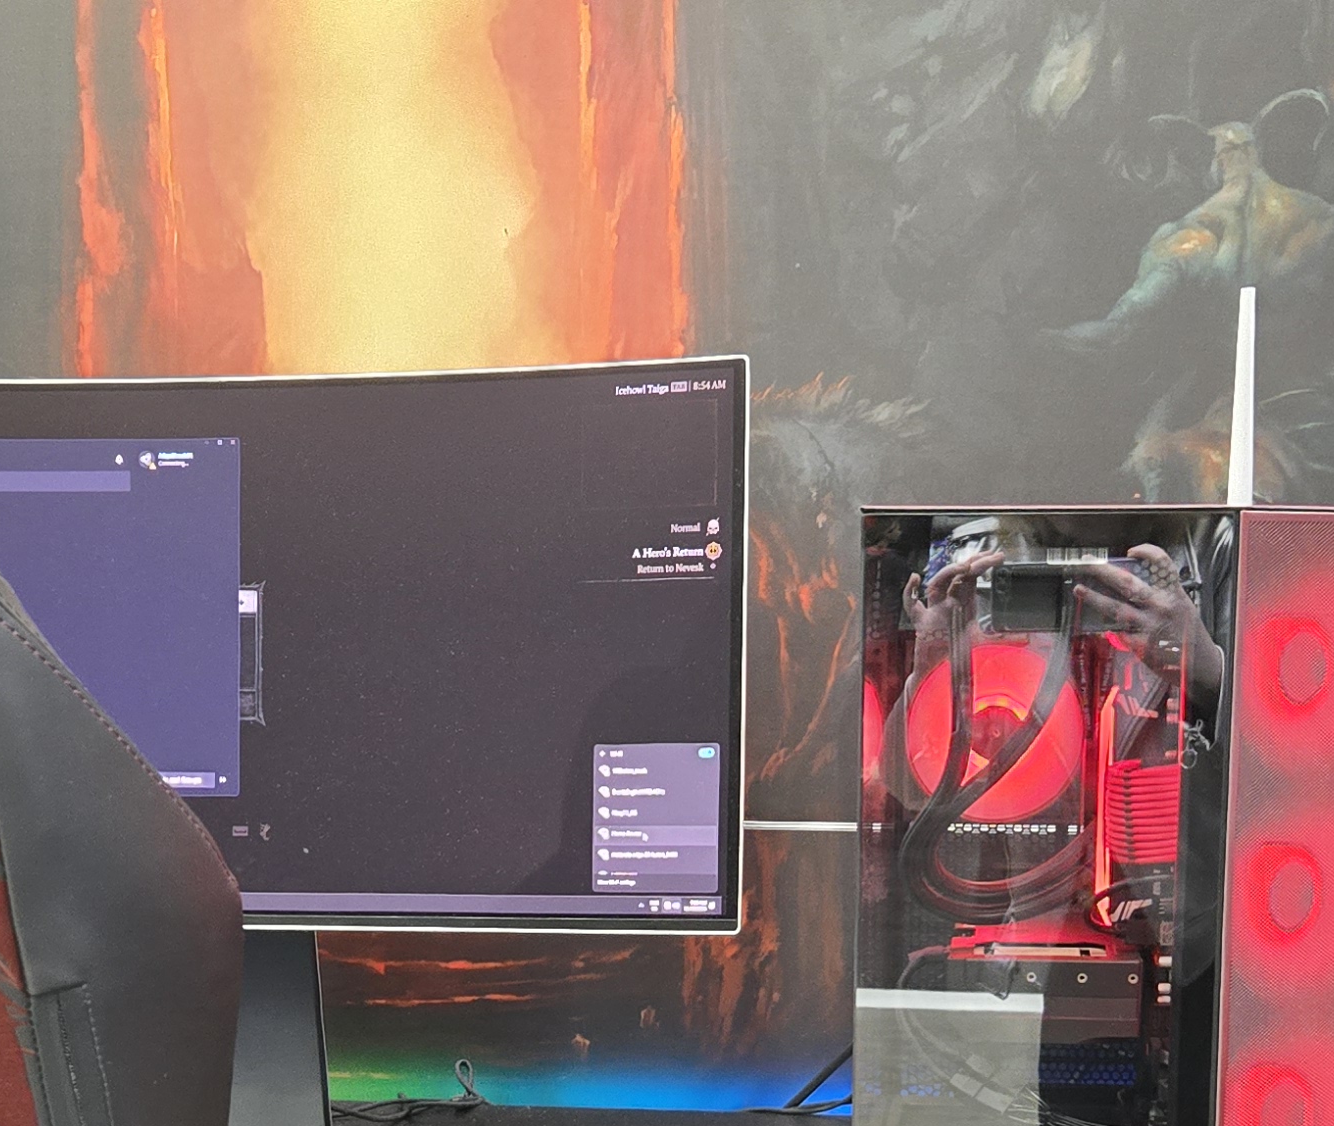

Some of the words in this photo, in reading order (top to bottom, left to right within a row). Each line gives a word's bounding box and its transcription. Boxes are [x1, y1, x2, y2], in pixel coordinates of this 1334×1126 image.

[647, 383, 669, 395] Taiga
[693, 380, 711, 391] 8:54
[711, 379, 727, 390] AM
[670, 522, 701, 533] Normal
[632, 548, 641, 558] A
[642, 547, 672, 558] Hero's
[672, 546, 704, 558] Return
[637, 564, 664, 574] Return
[665, 564, 675, 573] to
[675, 562, 704, 573] Nevesk
